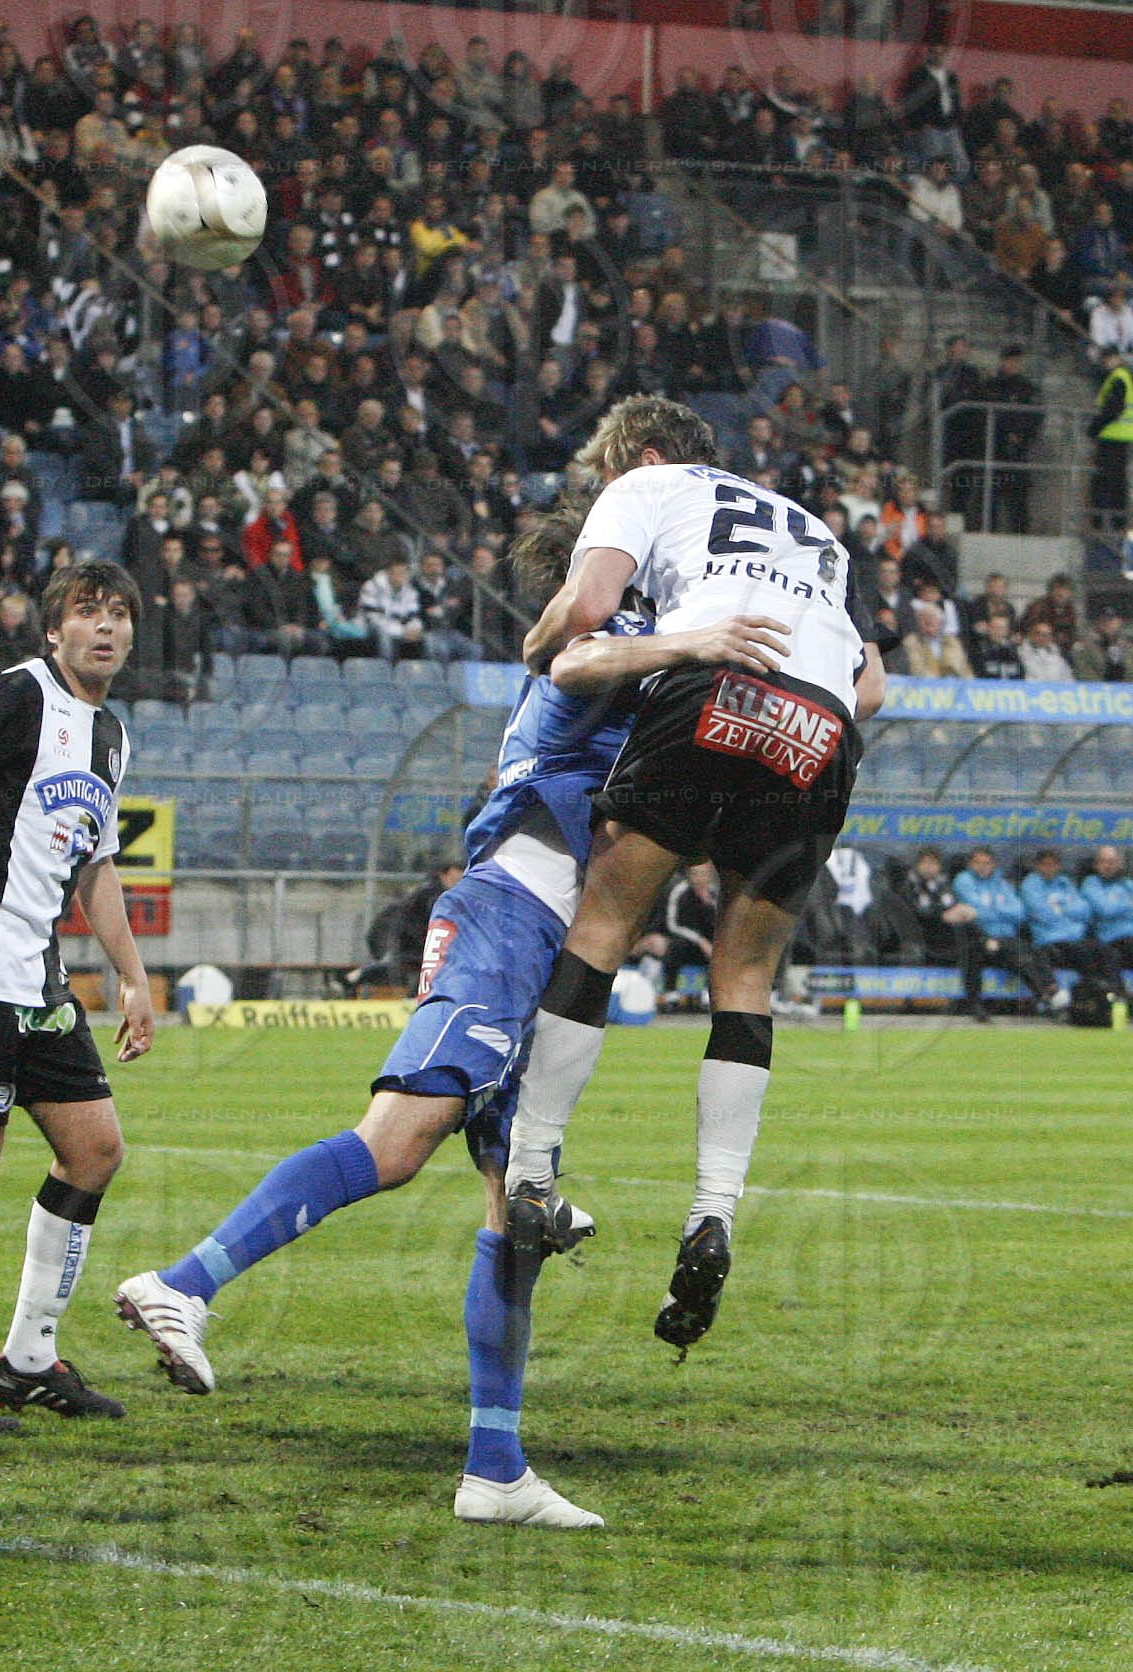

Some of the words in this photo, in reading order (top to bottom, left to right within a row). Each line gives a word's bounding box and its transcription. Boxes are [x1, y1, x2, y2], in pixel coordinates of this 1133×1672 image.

[714, 675, 837, 755] KLEINE
[703, 717, 818, 783] ZEITUNG
[242, 1005, 393, 1029] Raiffeisen
